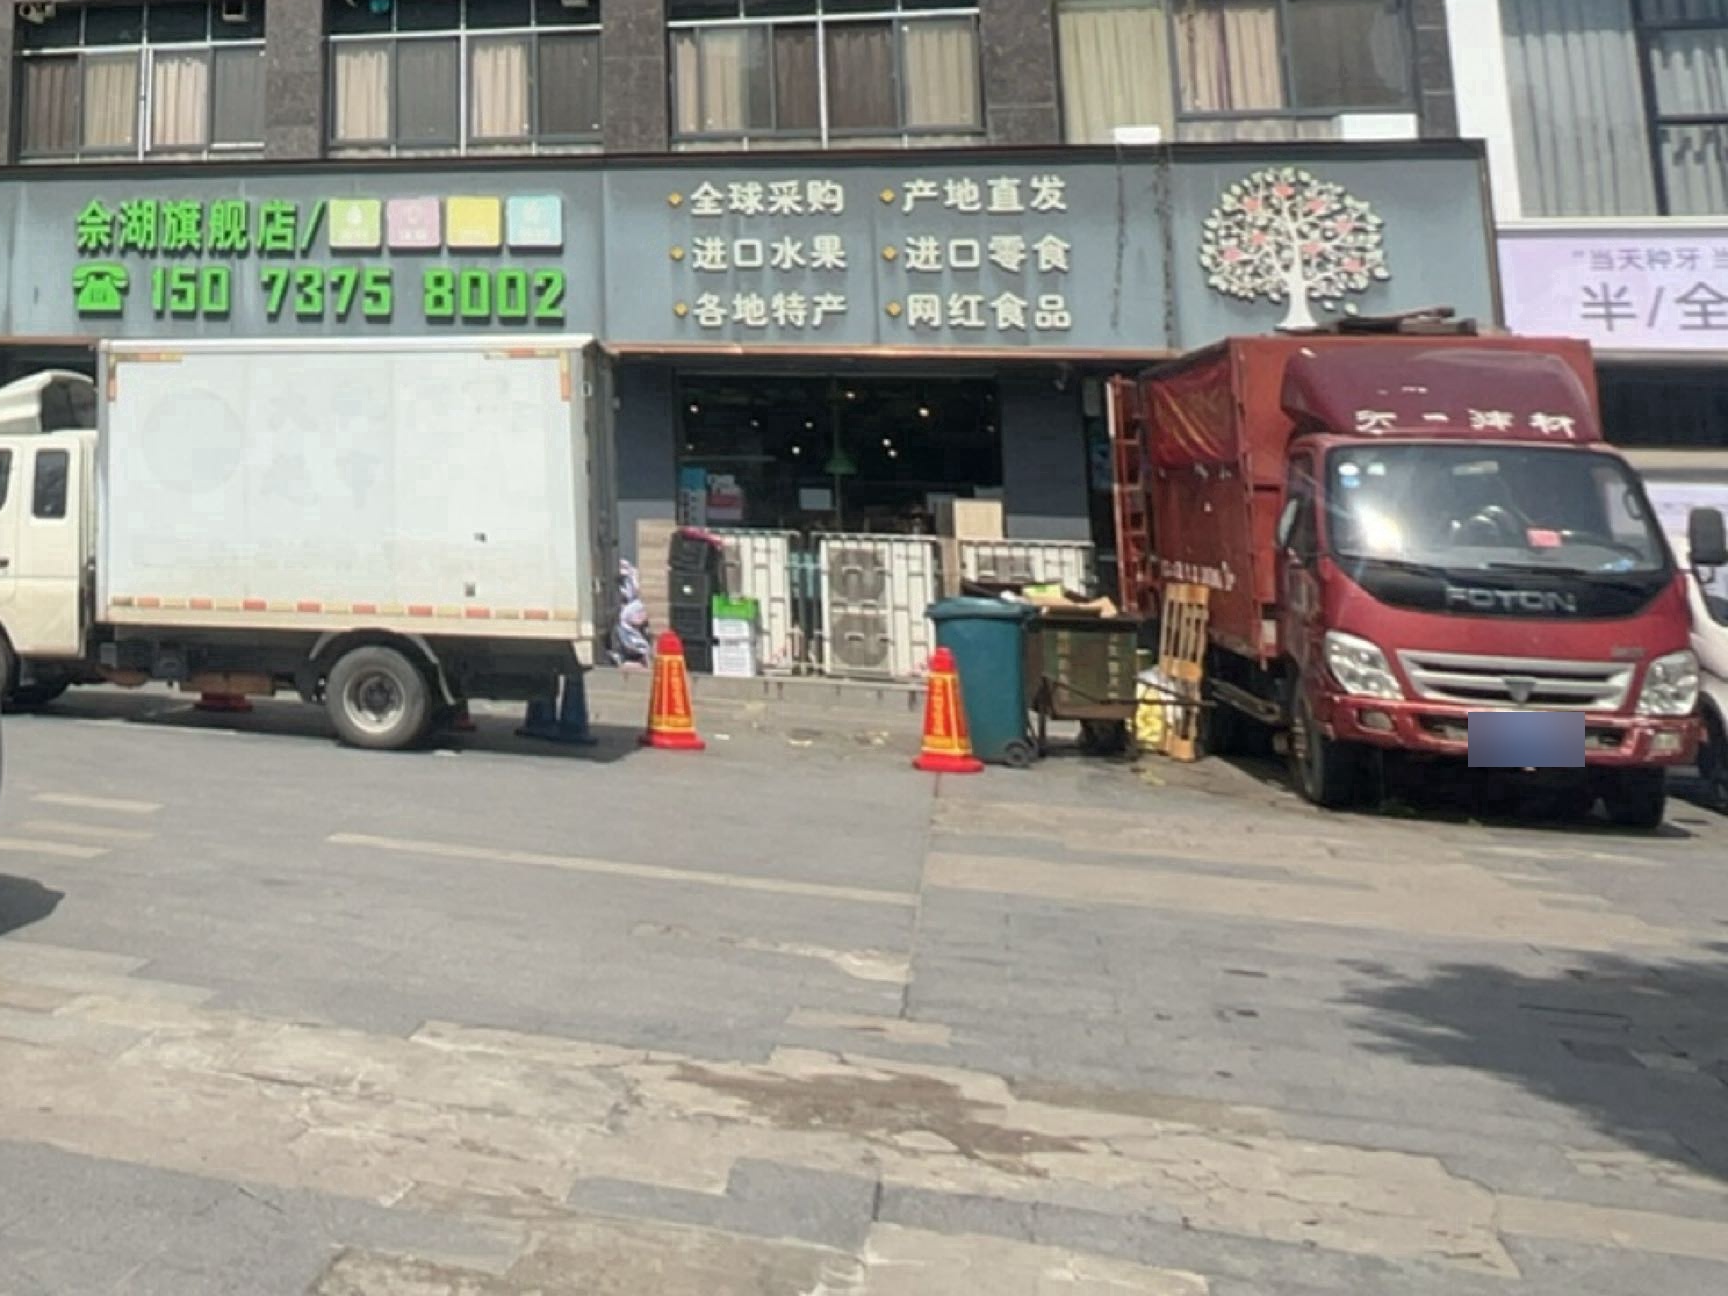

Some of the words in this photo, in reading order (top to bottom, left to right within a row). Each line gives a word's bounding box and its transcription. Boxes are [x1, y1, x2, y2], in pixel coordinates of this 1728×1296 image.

[690, 179, 846, 217] 全球采购
[901, 175, 1068, 214] 产地直发
[692, 235, 848, 271] 进口水果
[904, 234, 1071, 273] 进口零食
[152, 266, 231, 312] 150
[261, 266, 393, 316] 7375
[424, 267, 565, 318] 8002
[692, 292, 848, 330] 各地特产
[906, 291, 1072, 331] 网红食品
[1446, 586, 1577, 613] FOTON
